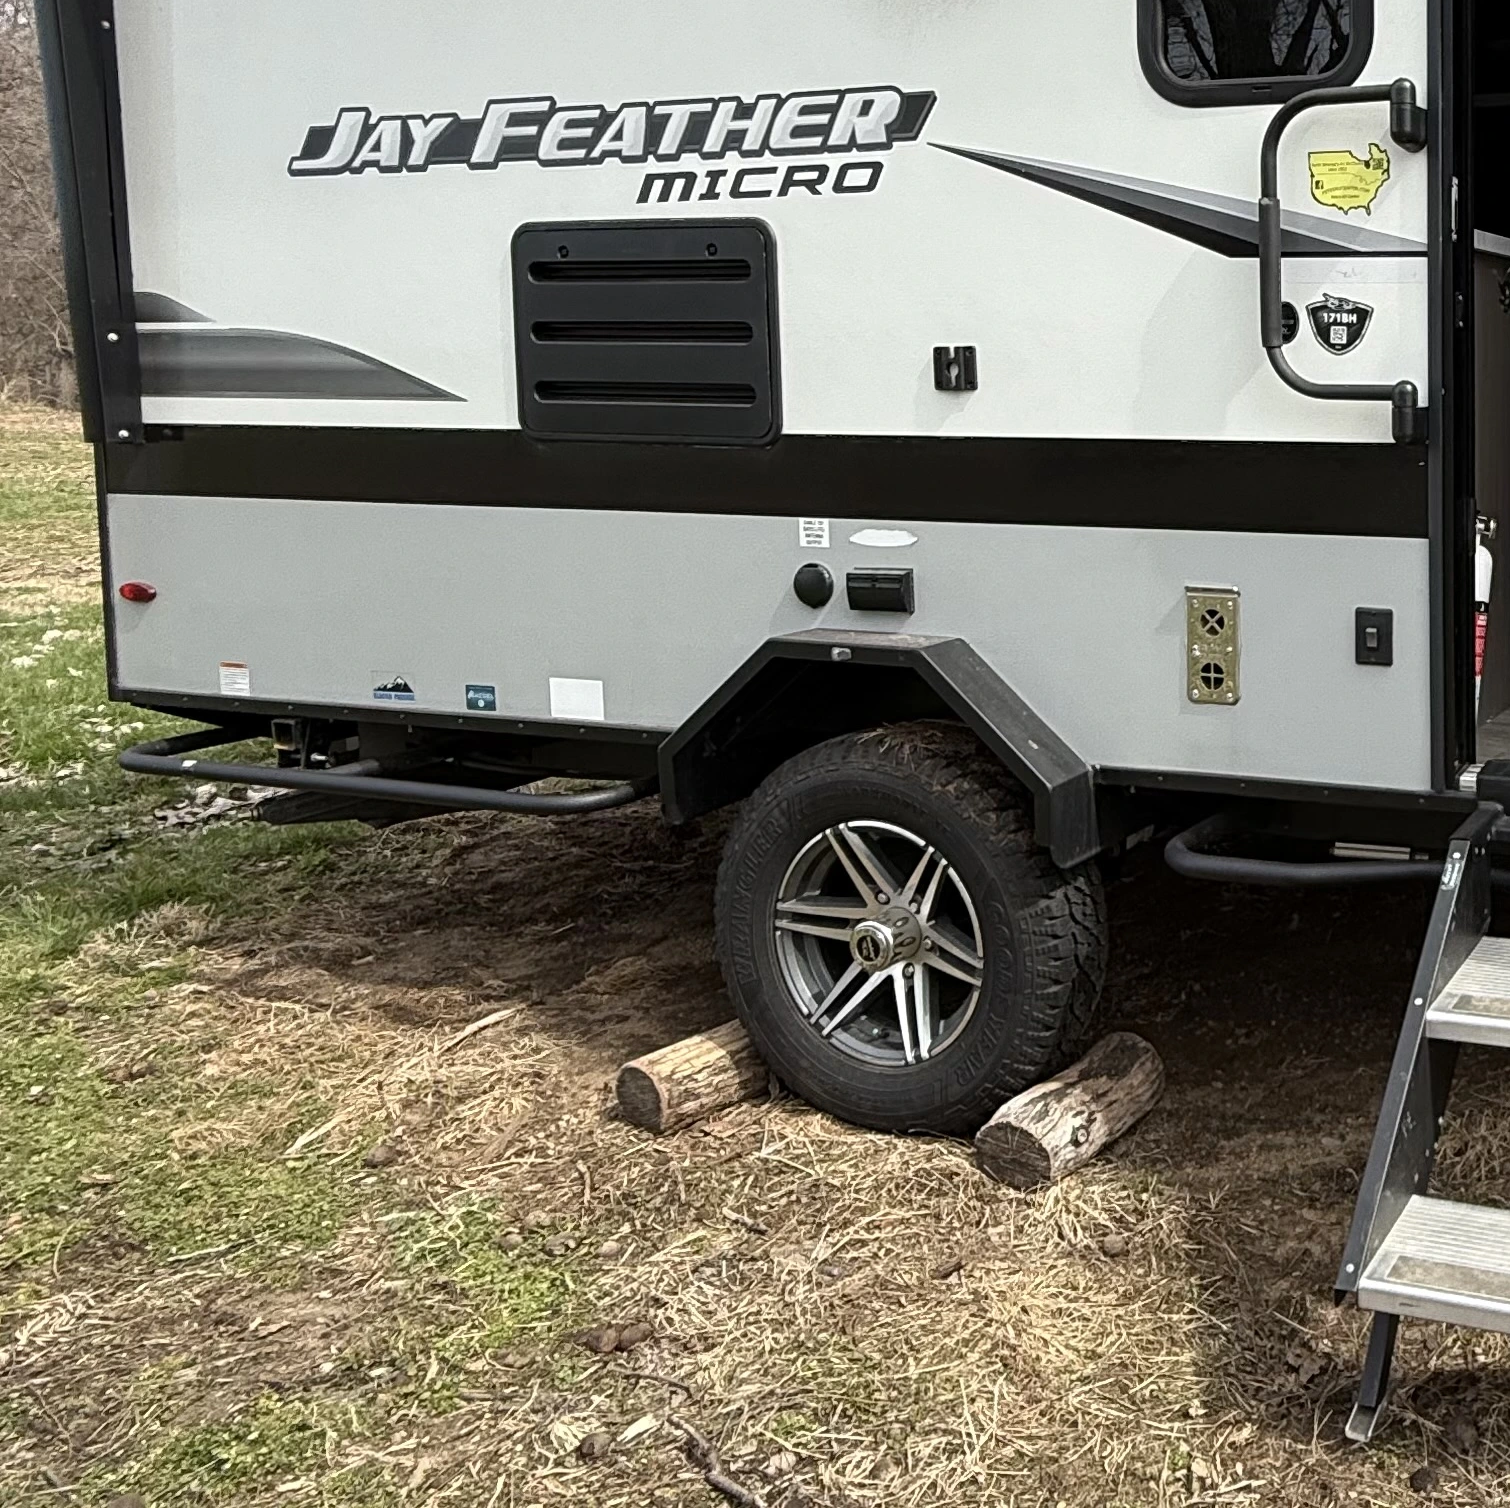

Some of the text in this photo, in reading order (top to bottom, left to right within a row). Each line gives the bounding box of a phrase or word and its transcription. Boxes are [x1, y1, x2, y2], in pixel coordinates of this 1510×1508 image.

[289, 86, 906, 174] JAY FEATHER
[636, 162, 884, 205] MICRO
[1322, 312, 1358, 325] 171BH
